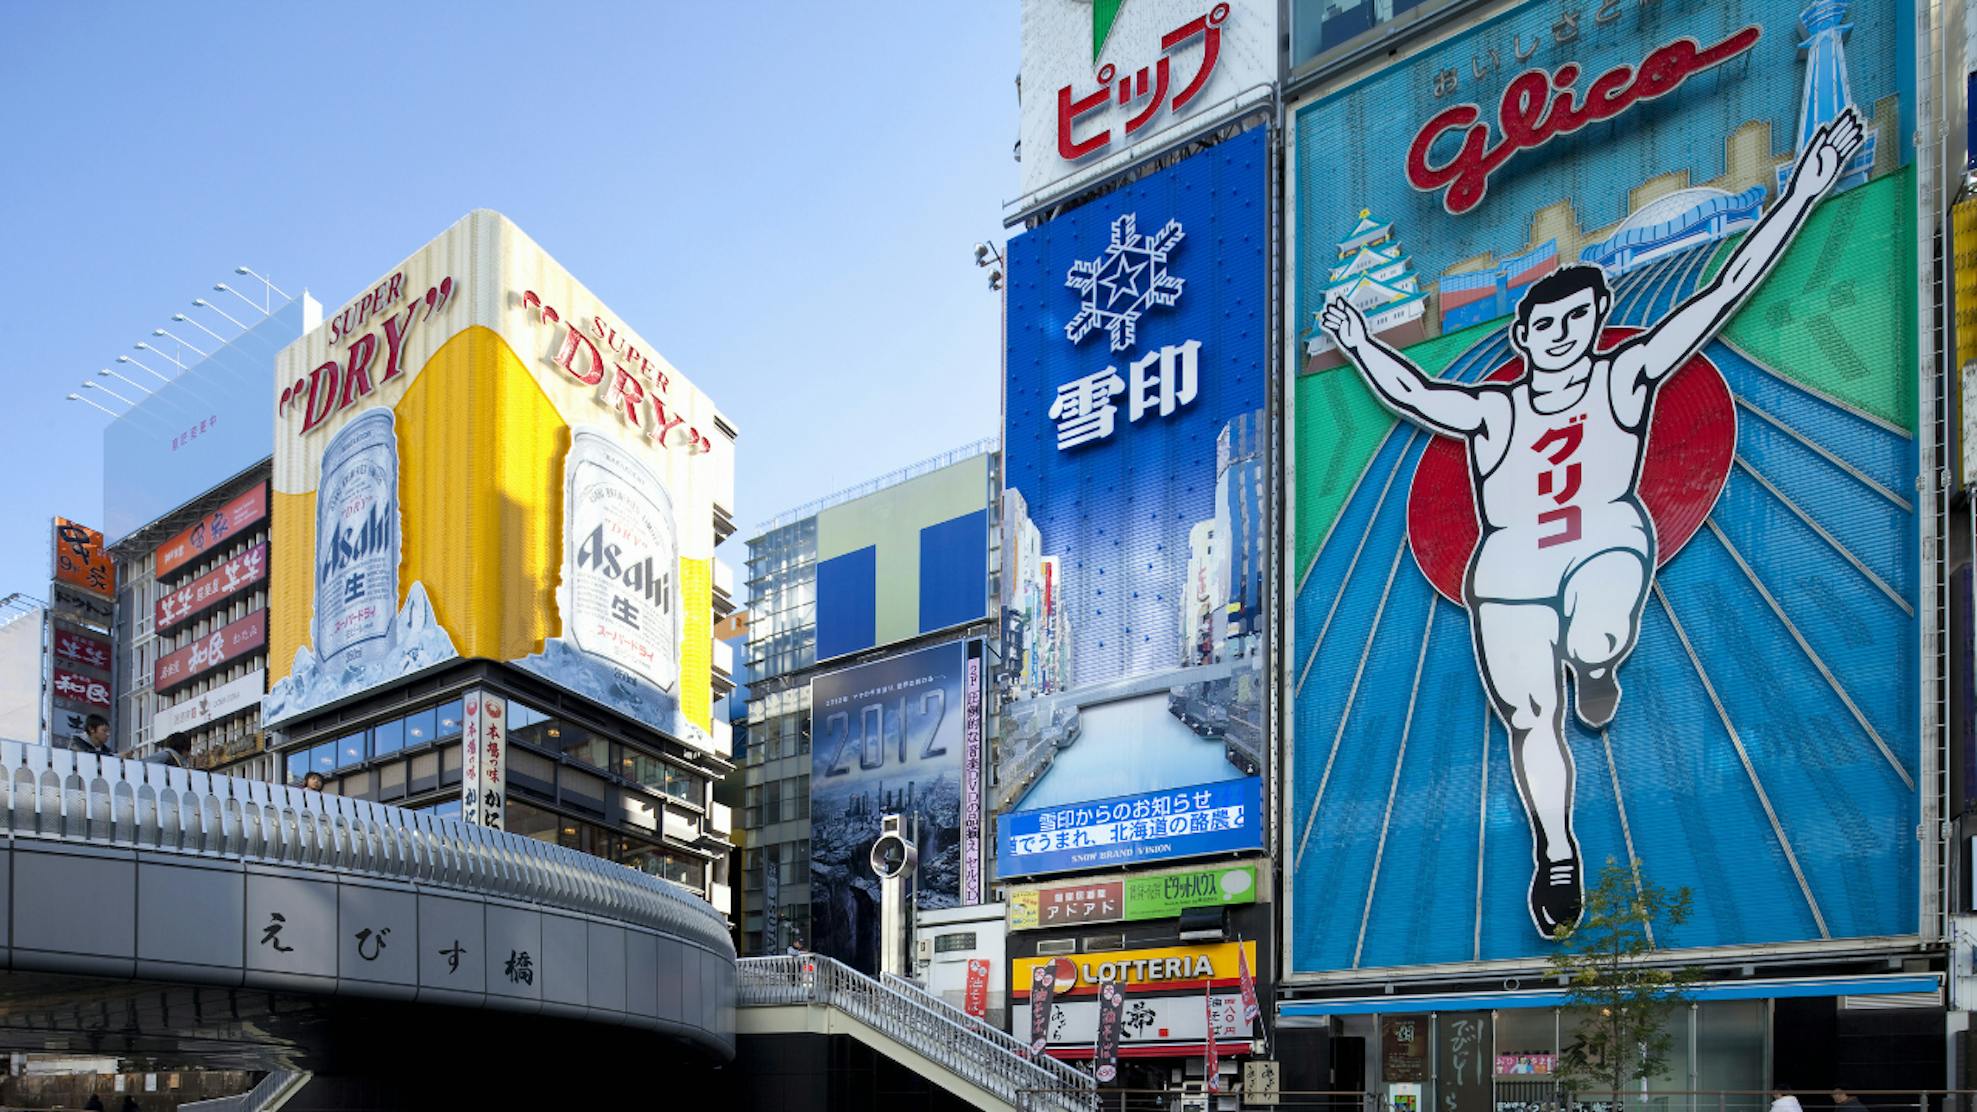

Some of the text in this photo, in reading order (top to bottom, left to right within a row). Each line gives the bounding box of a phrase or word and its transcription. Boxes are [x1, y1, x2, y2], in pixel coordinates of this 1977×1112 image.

[1058, 2, 1230, 160] ピップ
[1433, 0, 1655, 97] おいしさと
[329, 271, 404, 345] SUPER
[592, 316, 670, 394] SUPER
[1048, 339, 1202, 450] 雪印
[1531, 413, 1587, 549] グリコ
[323, 501, 389, 584] Asahi
[577, 523, 669, 615] Asahi
[344, 572, 365, 604] 生
[611, 595, 640, 631] 生
[825, 688, 947, 778] 2012
[1039, 790, 1212, 832] 雪印からのお知らせ
[1071, 843, 1172, 863] SNOW BRAND VISION
[1164, 874, 1217, 900] ピタットハウス
[260, 912, 535, 986] えびす橋
[1082, 955, 1214, 983] LOTTERIA
